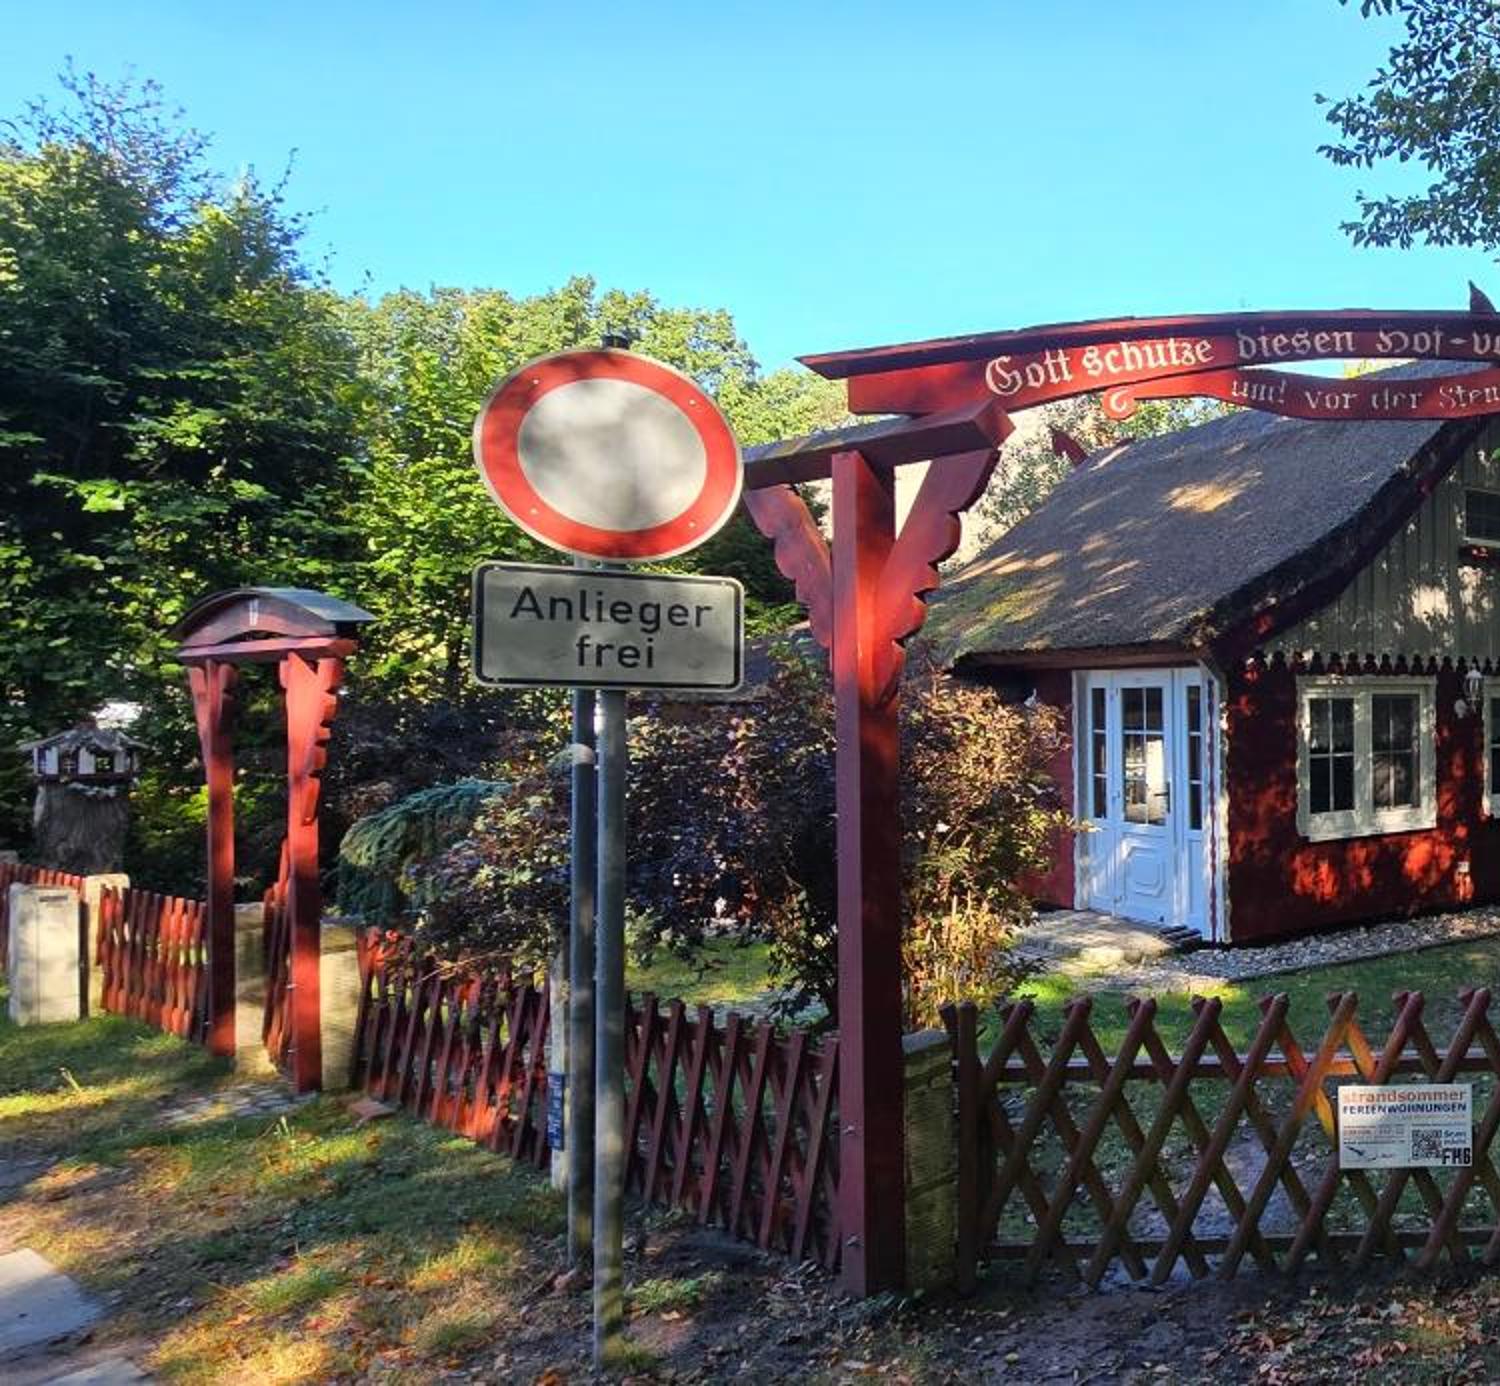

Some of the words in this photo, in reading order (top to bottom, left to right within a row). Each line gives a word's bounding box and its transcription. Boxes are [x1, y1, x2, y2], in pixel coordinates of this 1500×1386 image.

[985, 349, 1072, 396] Gott
[1236, 327, 1357, 360] diesen
[1305, 390, 1357, 410] vor
[1371, 387, 1424, 411] der
[510, 587, 713, 633] Anlieger
[576, 635, 655, 669] frei
[1343, 1103, 1467, 1115] FERIENWOHNUNGEN
